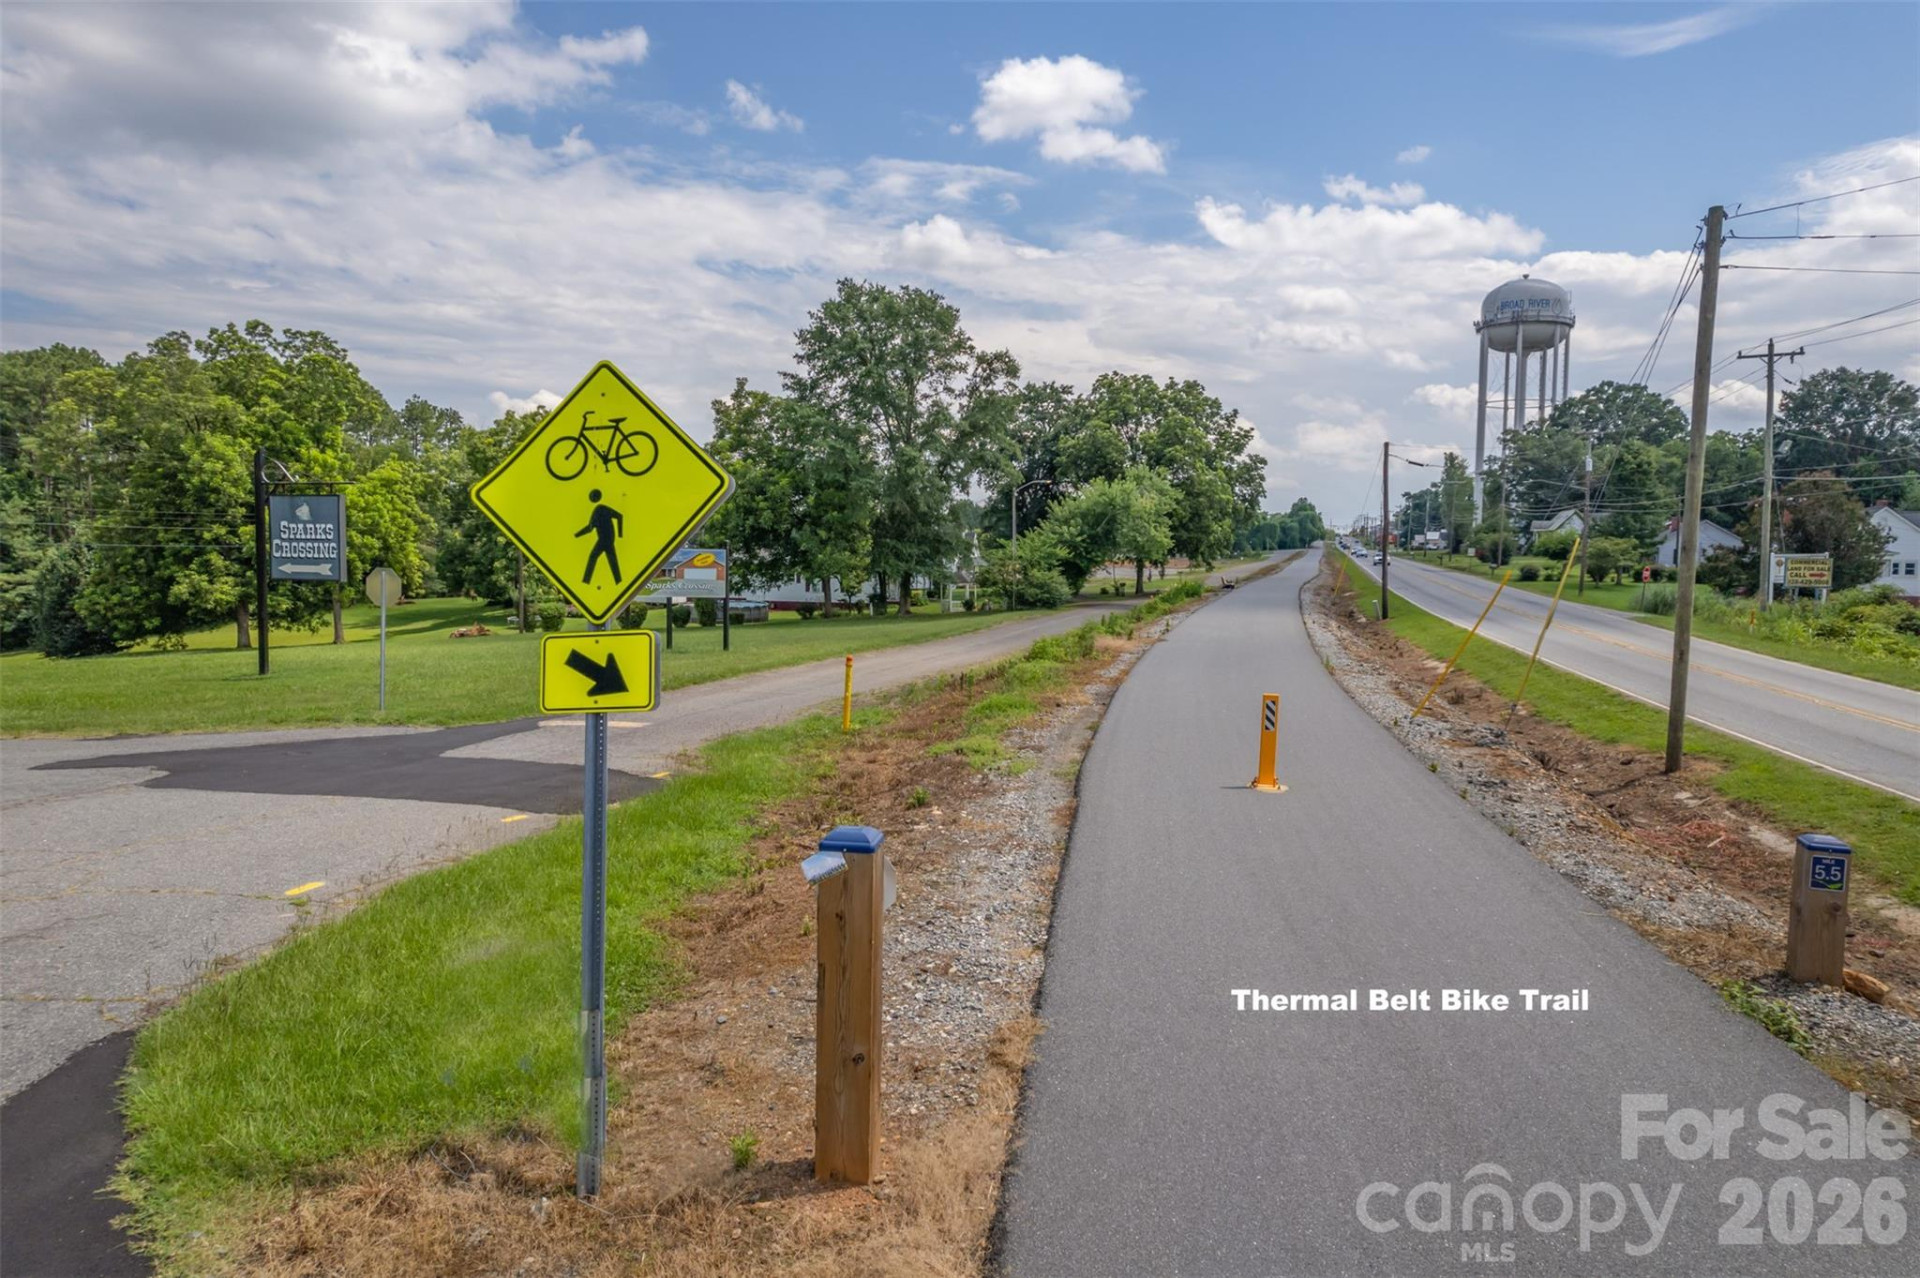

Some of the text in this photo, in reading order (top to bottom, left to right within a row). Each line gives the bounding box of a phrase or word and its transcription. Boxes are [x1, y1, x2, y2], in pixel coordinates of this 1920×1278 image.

[1500, 299, 1551, 310] BROAD RIVER
[645, 581, 676, 591] Sparks
[1814, 865, 1841, 881] 5.5
